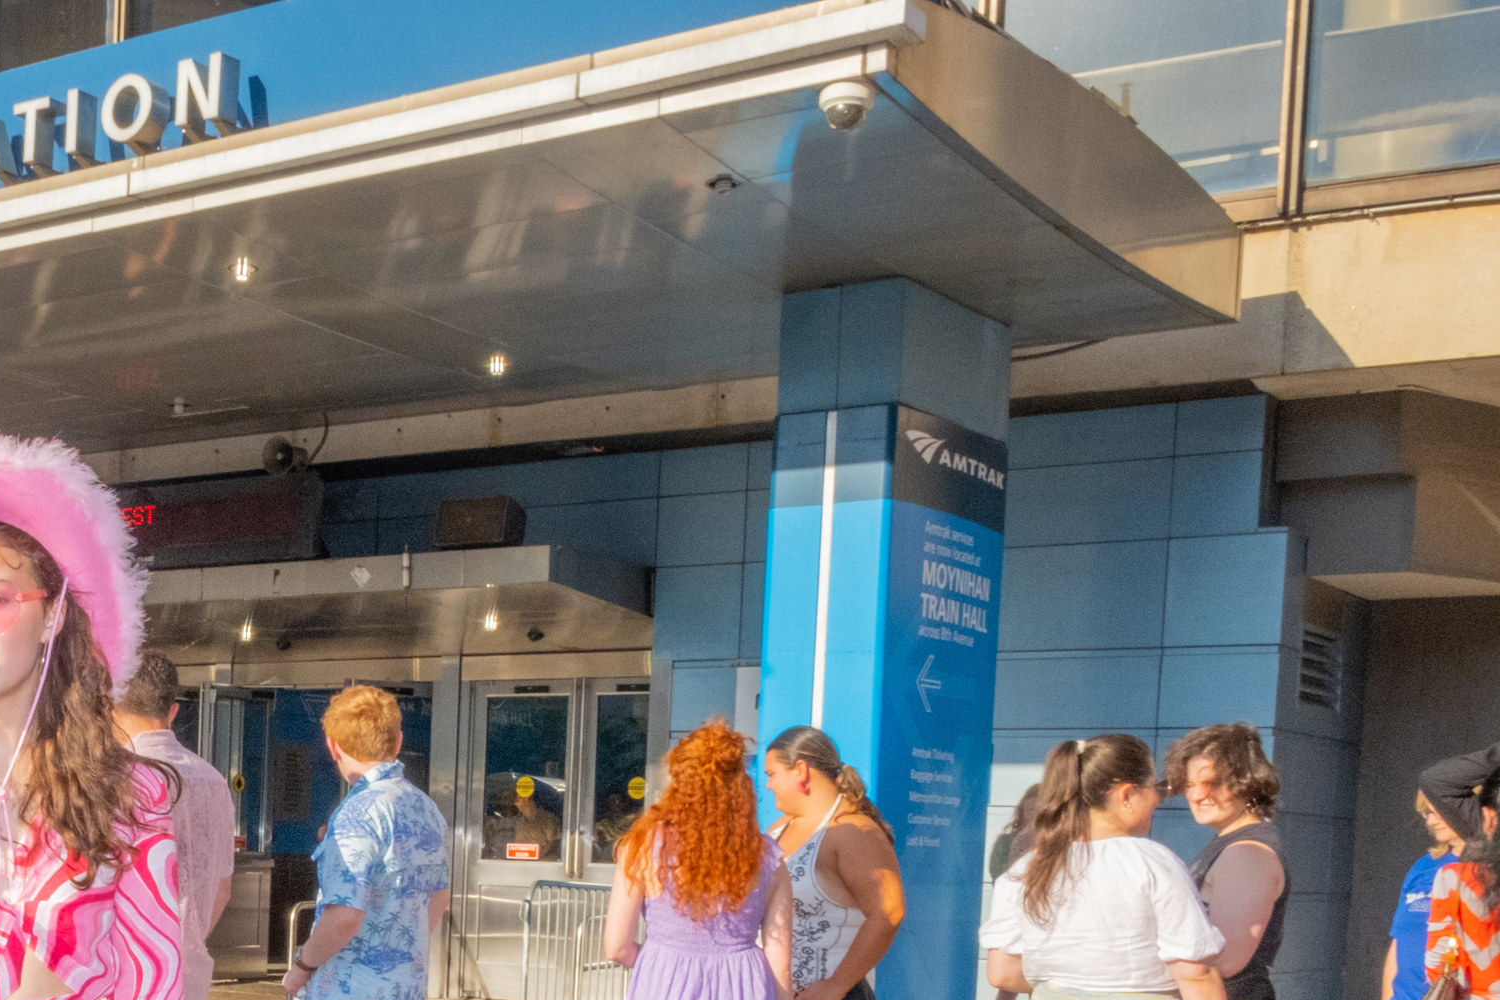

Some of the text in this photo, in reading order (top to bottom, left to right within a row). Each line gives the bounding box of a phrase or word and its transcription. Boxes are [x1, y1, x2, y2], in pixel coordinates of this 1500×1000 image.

[938, 449, 1004, 490] AMTRAK
[921, 559, 991, 603] MOYNIHAN
[920, 592, 988, 634] TRAIN HALL
